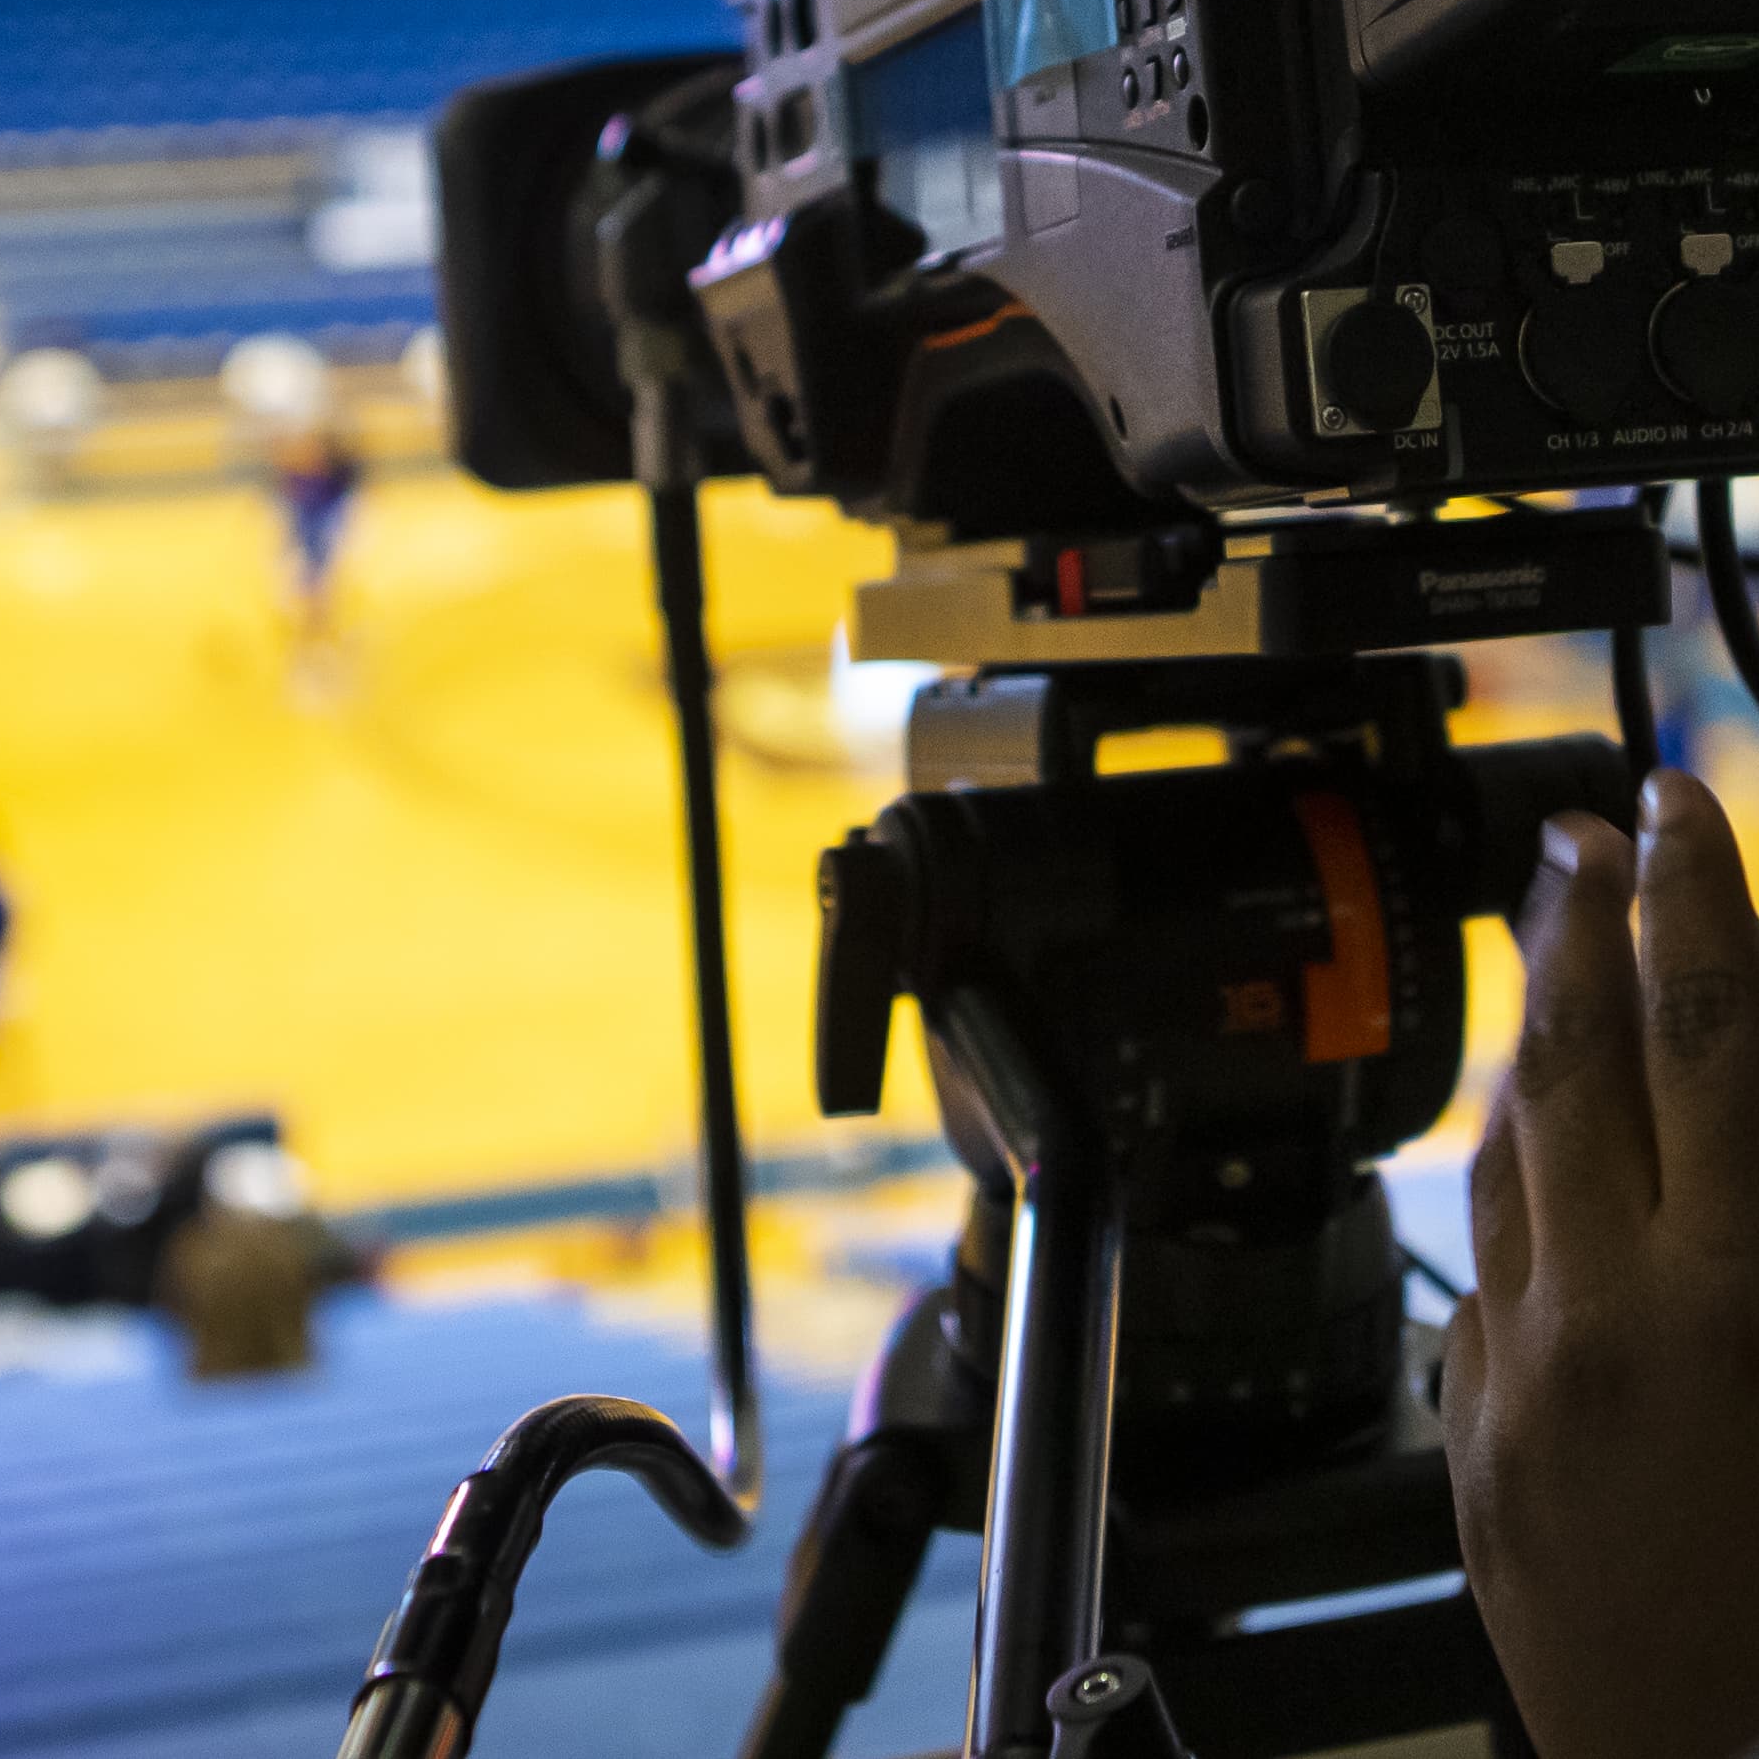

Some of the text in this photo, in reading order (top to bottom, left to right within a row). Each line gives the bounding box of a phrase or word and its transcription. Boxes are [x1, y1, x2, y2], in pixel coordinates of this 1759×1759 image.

[1604, 241, 1633, 257] OFF
[1460, 322, 1496, 339] OUT
[1438, 344, 1459, 361] 2V
[1393, 432, 1440, 450] DC IN
[1546, 420, 1754, 450] CH 1/3 AUDIO IN CH 2/4
[1417, 563, 1547, 594] Panasonic
